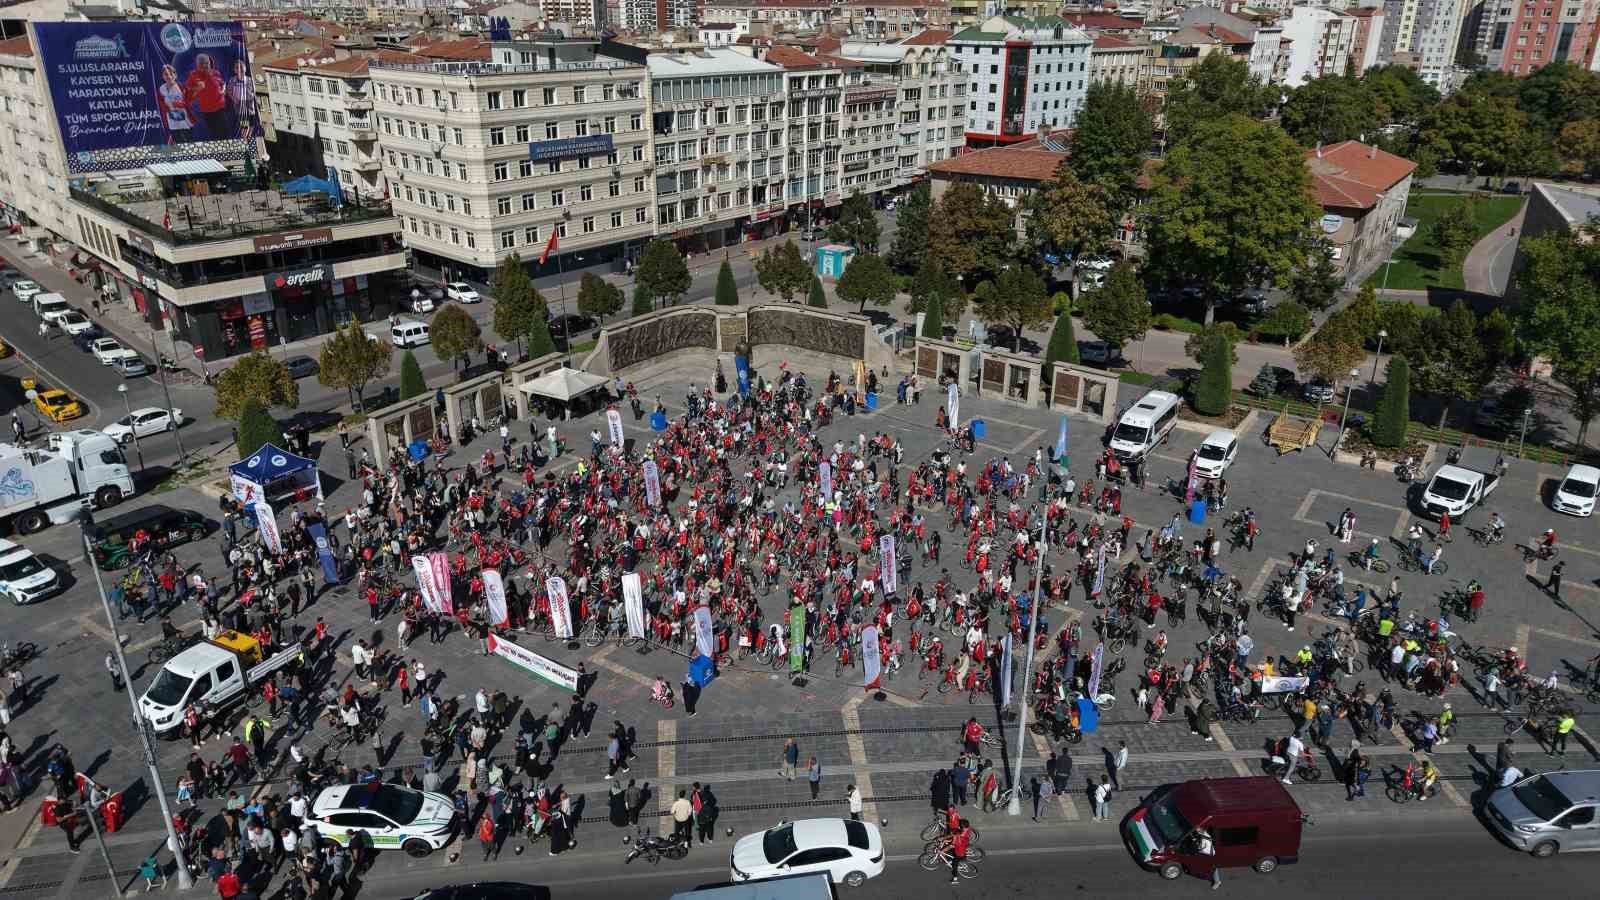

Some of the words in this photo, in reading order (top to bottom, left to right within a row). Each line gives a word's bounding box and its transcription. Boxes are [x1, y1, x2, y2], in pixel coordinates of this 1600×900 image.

[115, 73, 139, 84] YARI
[68, 86, 147, 99] MARATONU'NA
[88, 99, 133, 111] KATILAN
[65, 112, 89, 124] TÜM
[91, 110, 161, 122] SPORCULARA
[286, 269, 325, 286] arçelik
